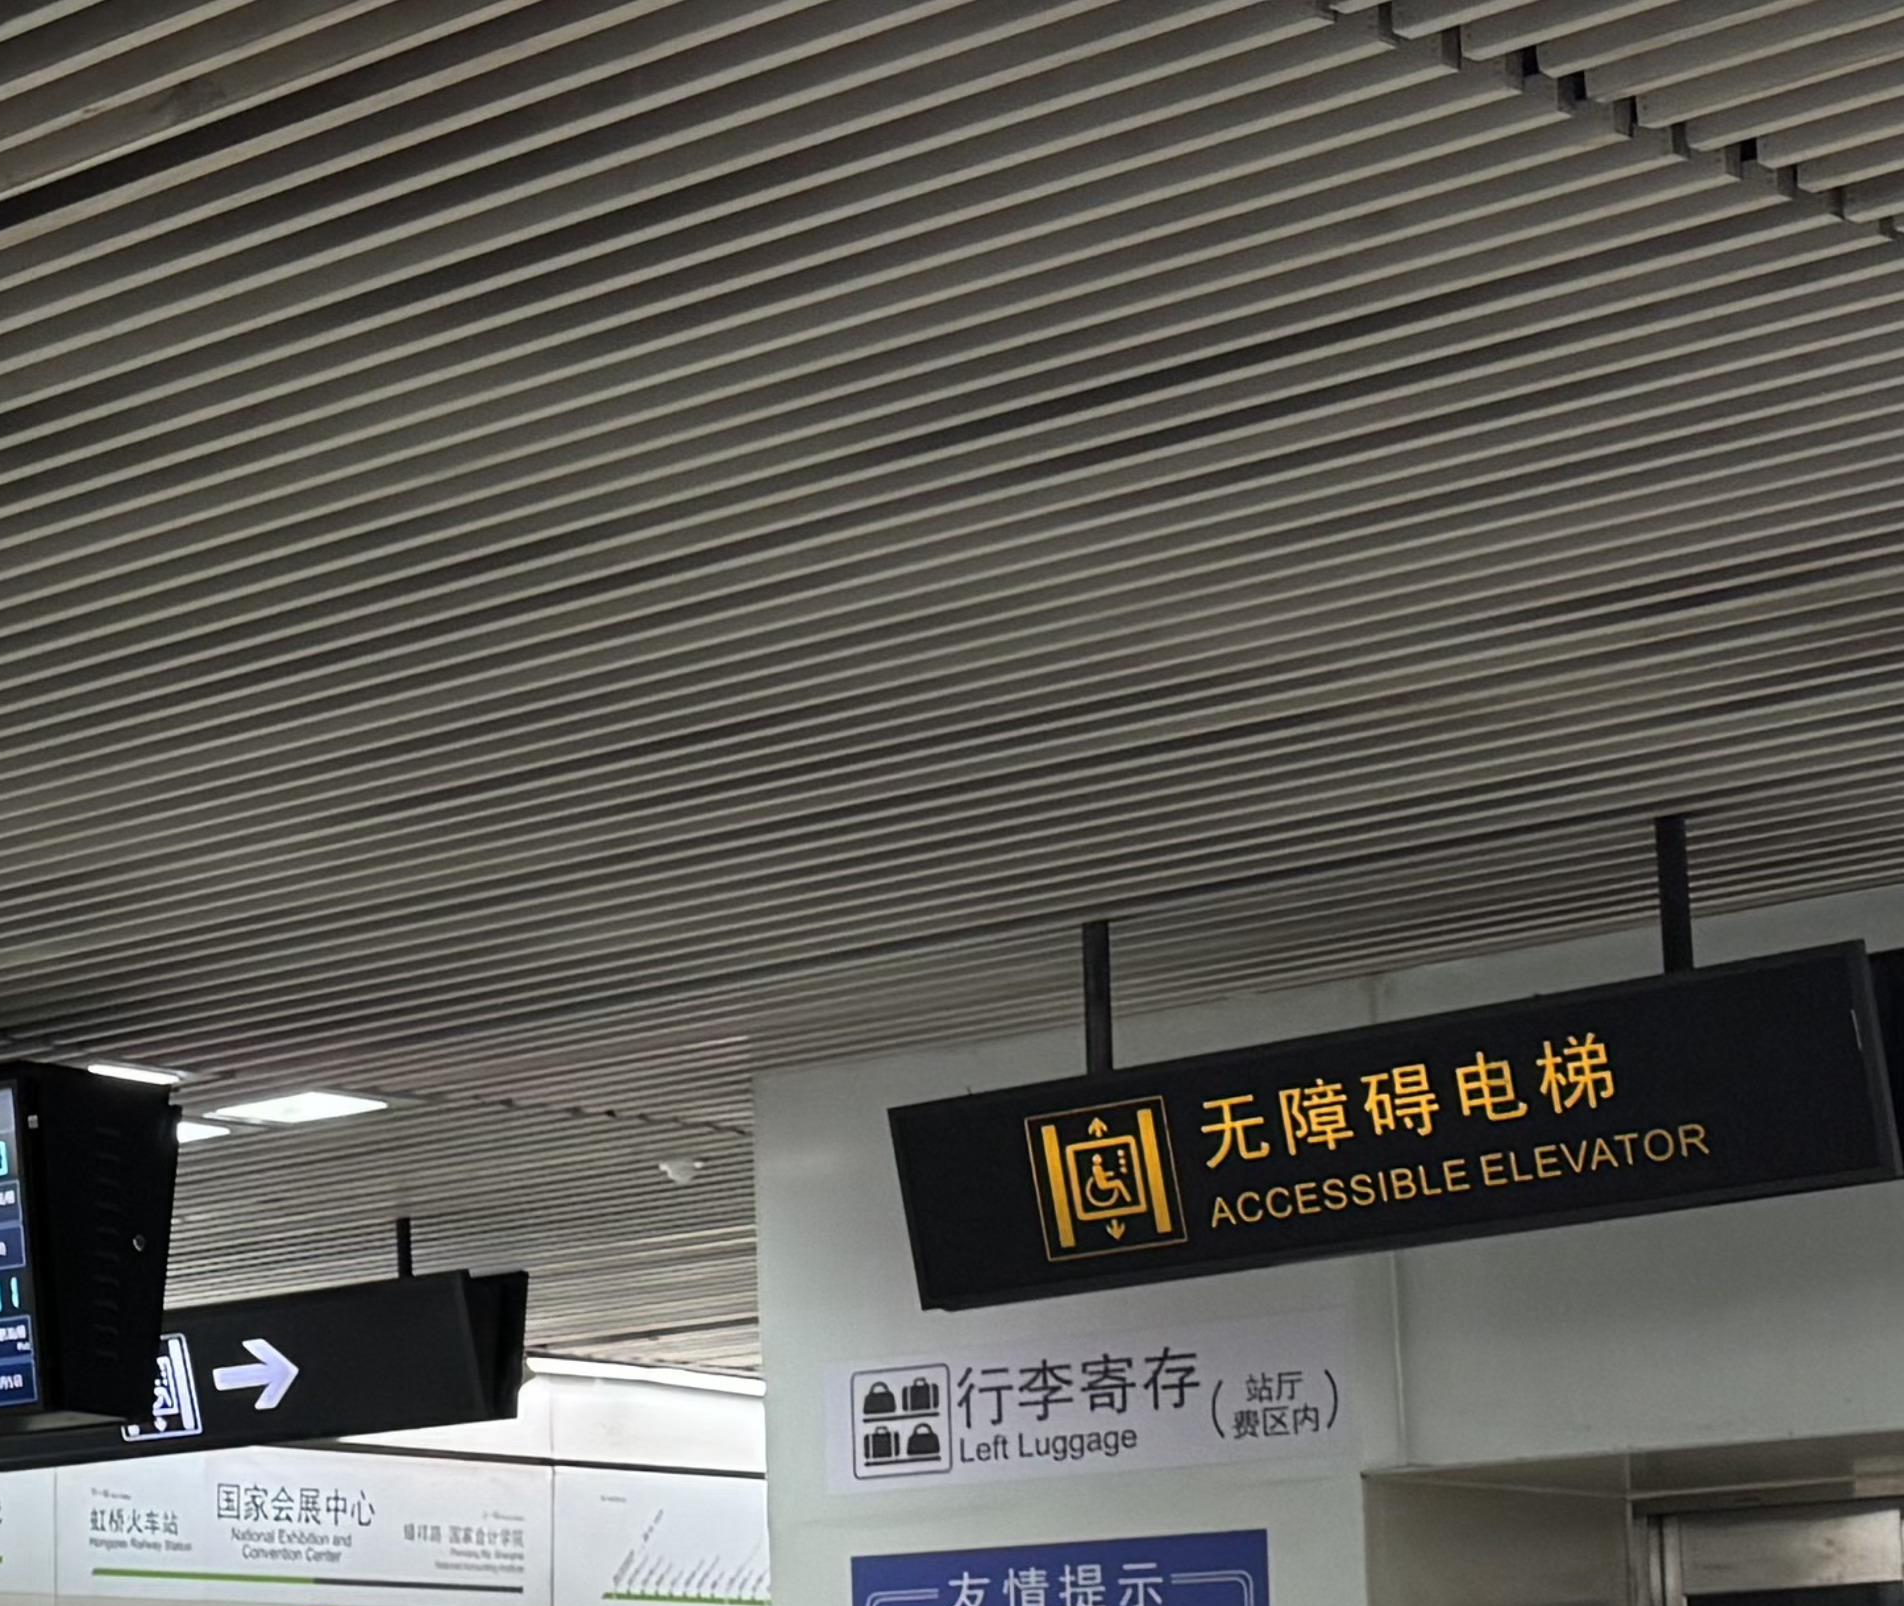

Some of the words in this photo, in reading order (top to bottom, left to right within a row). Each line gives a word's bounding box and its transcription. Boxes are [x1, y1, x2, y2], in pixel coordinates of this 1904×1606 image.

[1199, 1031, 1617, 1172] 无障碍电梯
[1209, 1158, 1473, 1230] ACCESSIBLE
[1480, 1121, 1713, 1190] ELEVATOR
[956, 1346, 1201, 1430] 行李寄存
[959, 1434, 1009, 1463] Left
[1019, 1426, 1138, 1462] Luggage
[90, 1507, 179, 1537] 虹桥火车站
[217, 1482, 376, 1527] 国家会展中心
